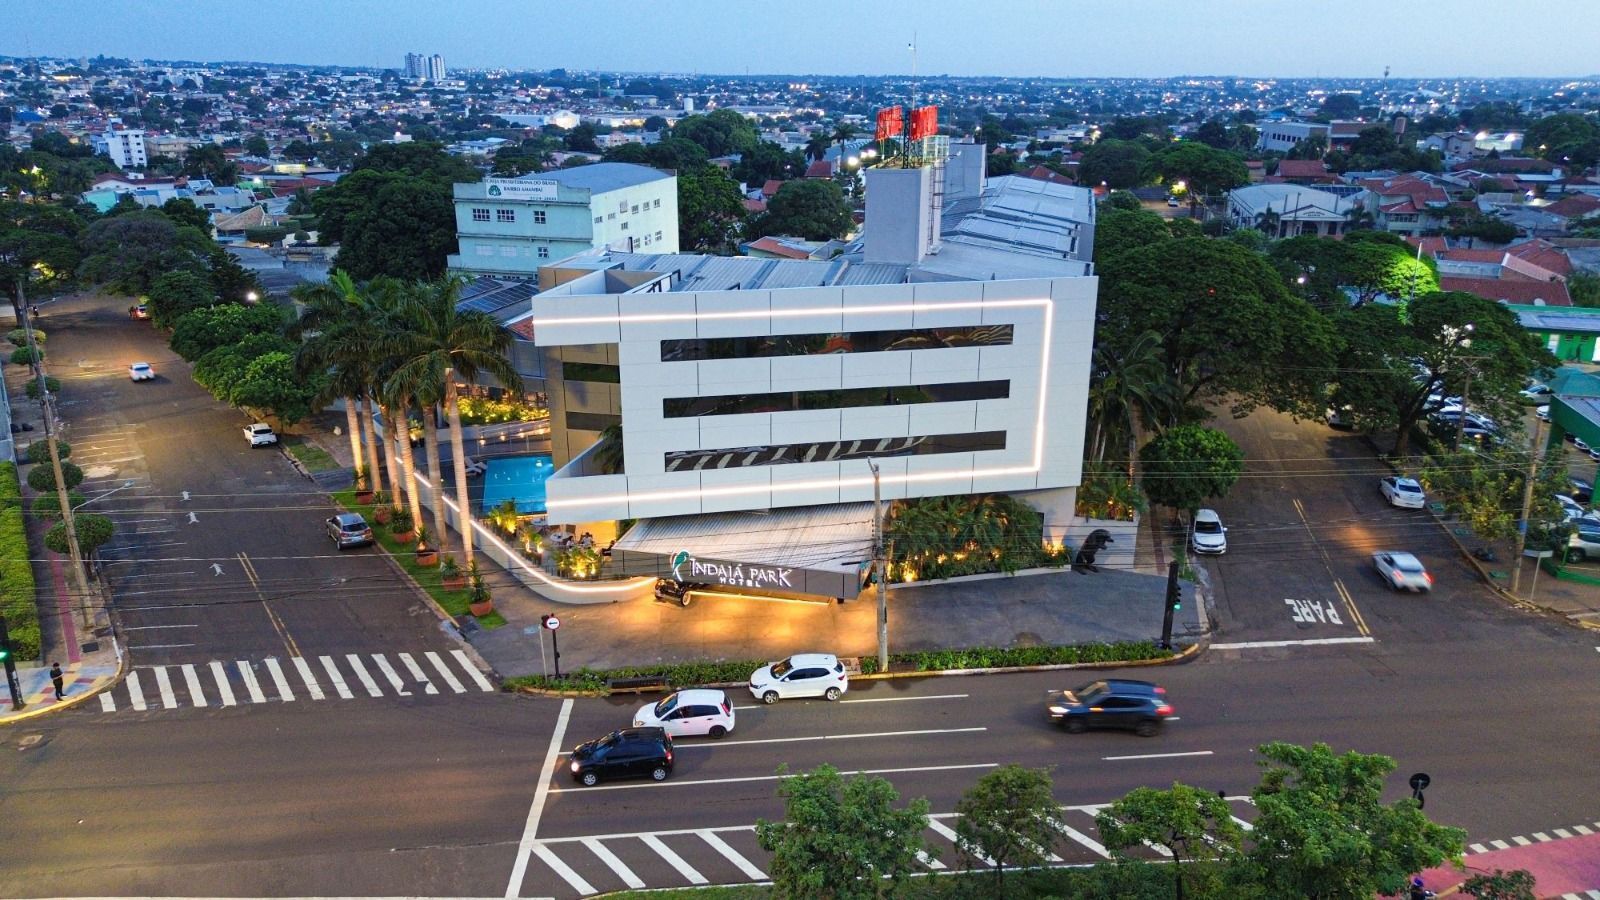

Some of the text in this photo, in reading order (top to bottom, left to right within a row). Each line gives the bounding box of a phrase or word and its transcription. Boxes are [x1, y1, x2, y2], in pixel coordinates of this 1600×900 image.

[689, 558, 793, 587] INDAIÁ PARK
[719, 577, 761, 588] HOTEL
[1284, 598, 1343, 625] PARE
